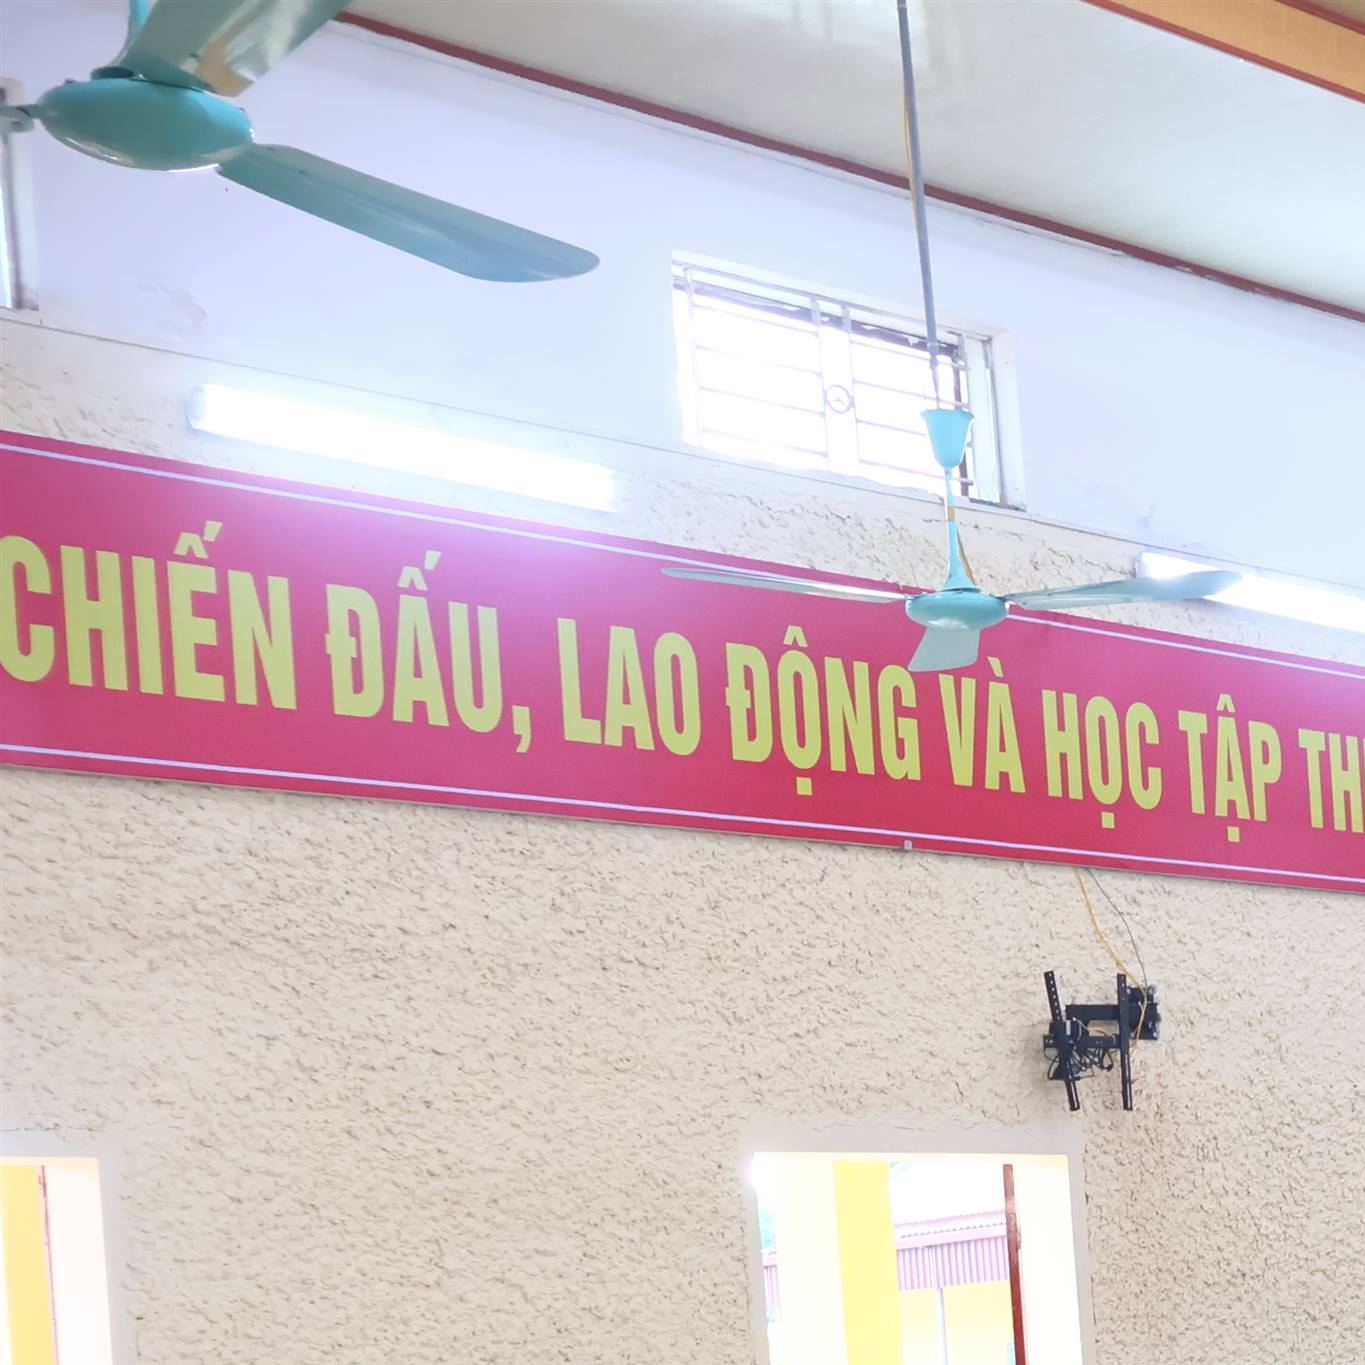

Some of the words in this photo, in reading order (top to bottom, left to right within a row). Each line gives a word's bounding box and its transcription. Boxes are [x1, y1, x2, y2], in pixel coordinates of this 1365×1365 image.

[0, 521, 297, 710] CHIẾN
[325, 550, 531, 754] ĐẤU,
[557, 617, 701, 756] LAO
[725, 626, 922, 797] ĐỘNG
[939, 656, 1027, 794] VÀ
[1042, 689, 1163, 830] HỌC
[1179, 694, 1283, 843] TẬP
